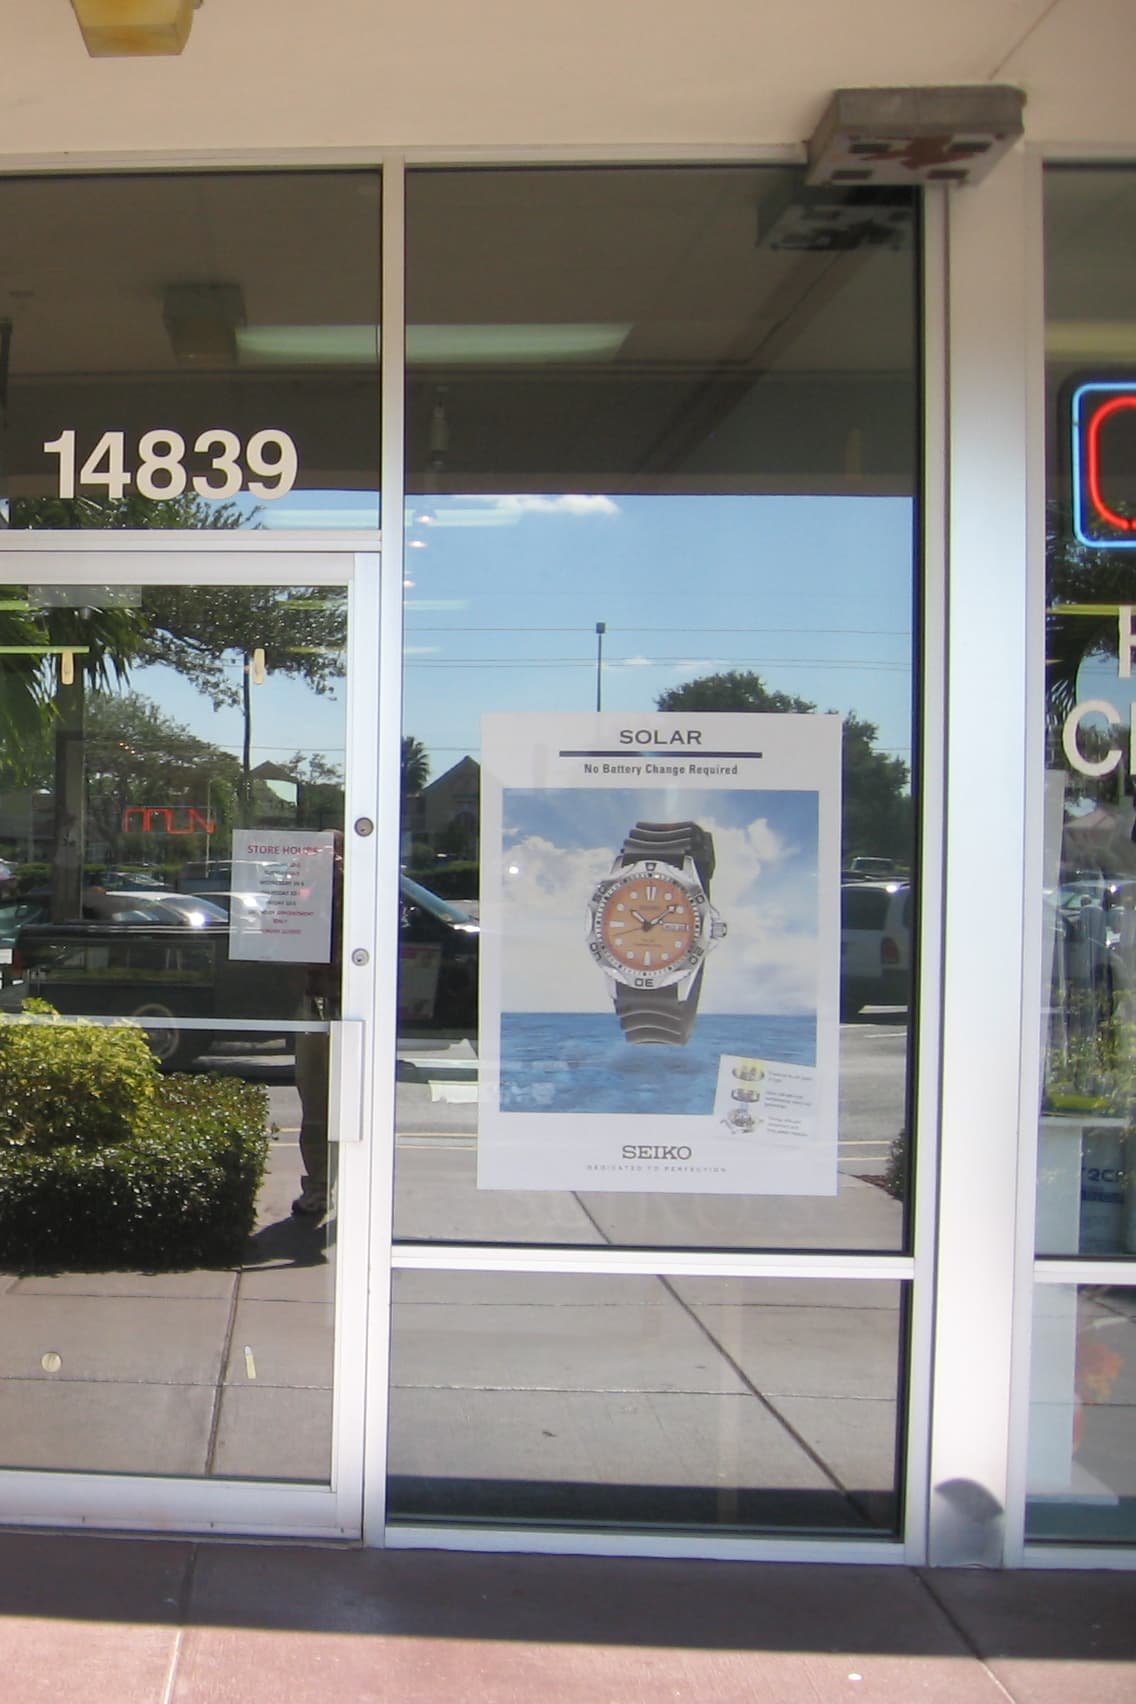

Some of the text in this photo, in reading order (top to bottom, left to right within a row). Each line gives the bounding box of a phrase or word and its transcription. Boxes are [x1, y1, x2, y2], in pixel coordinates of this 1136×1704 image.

[44, 429, 298, 500] 14839
[619, 729, 702, 745] SOLAR
[584, 763, 738, 776] No Battery Change Required
[247, 845, 280, 855] STORE
[622, 1144, 693, 1160] SEIKO
